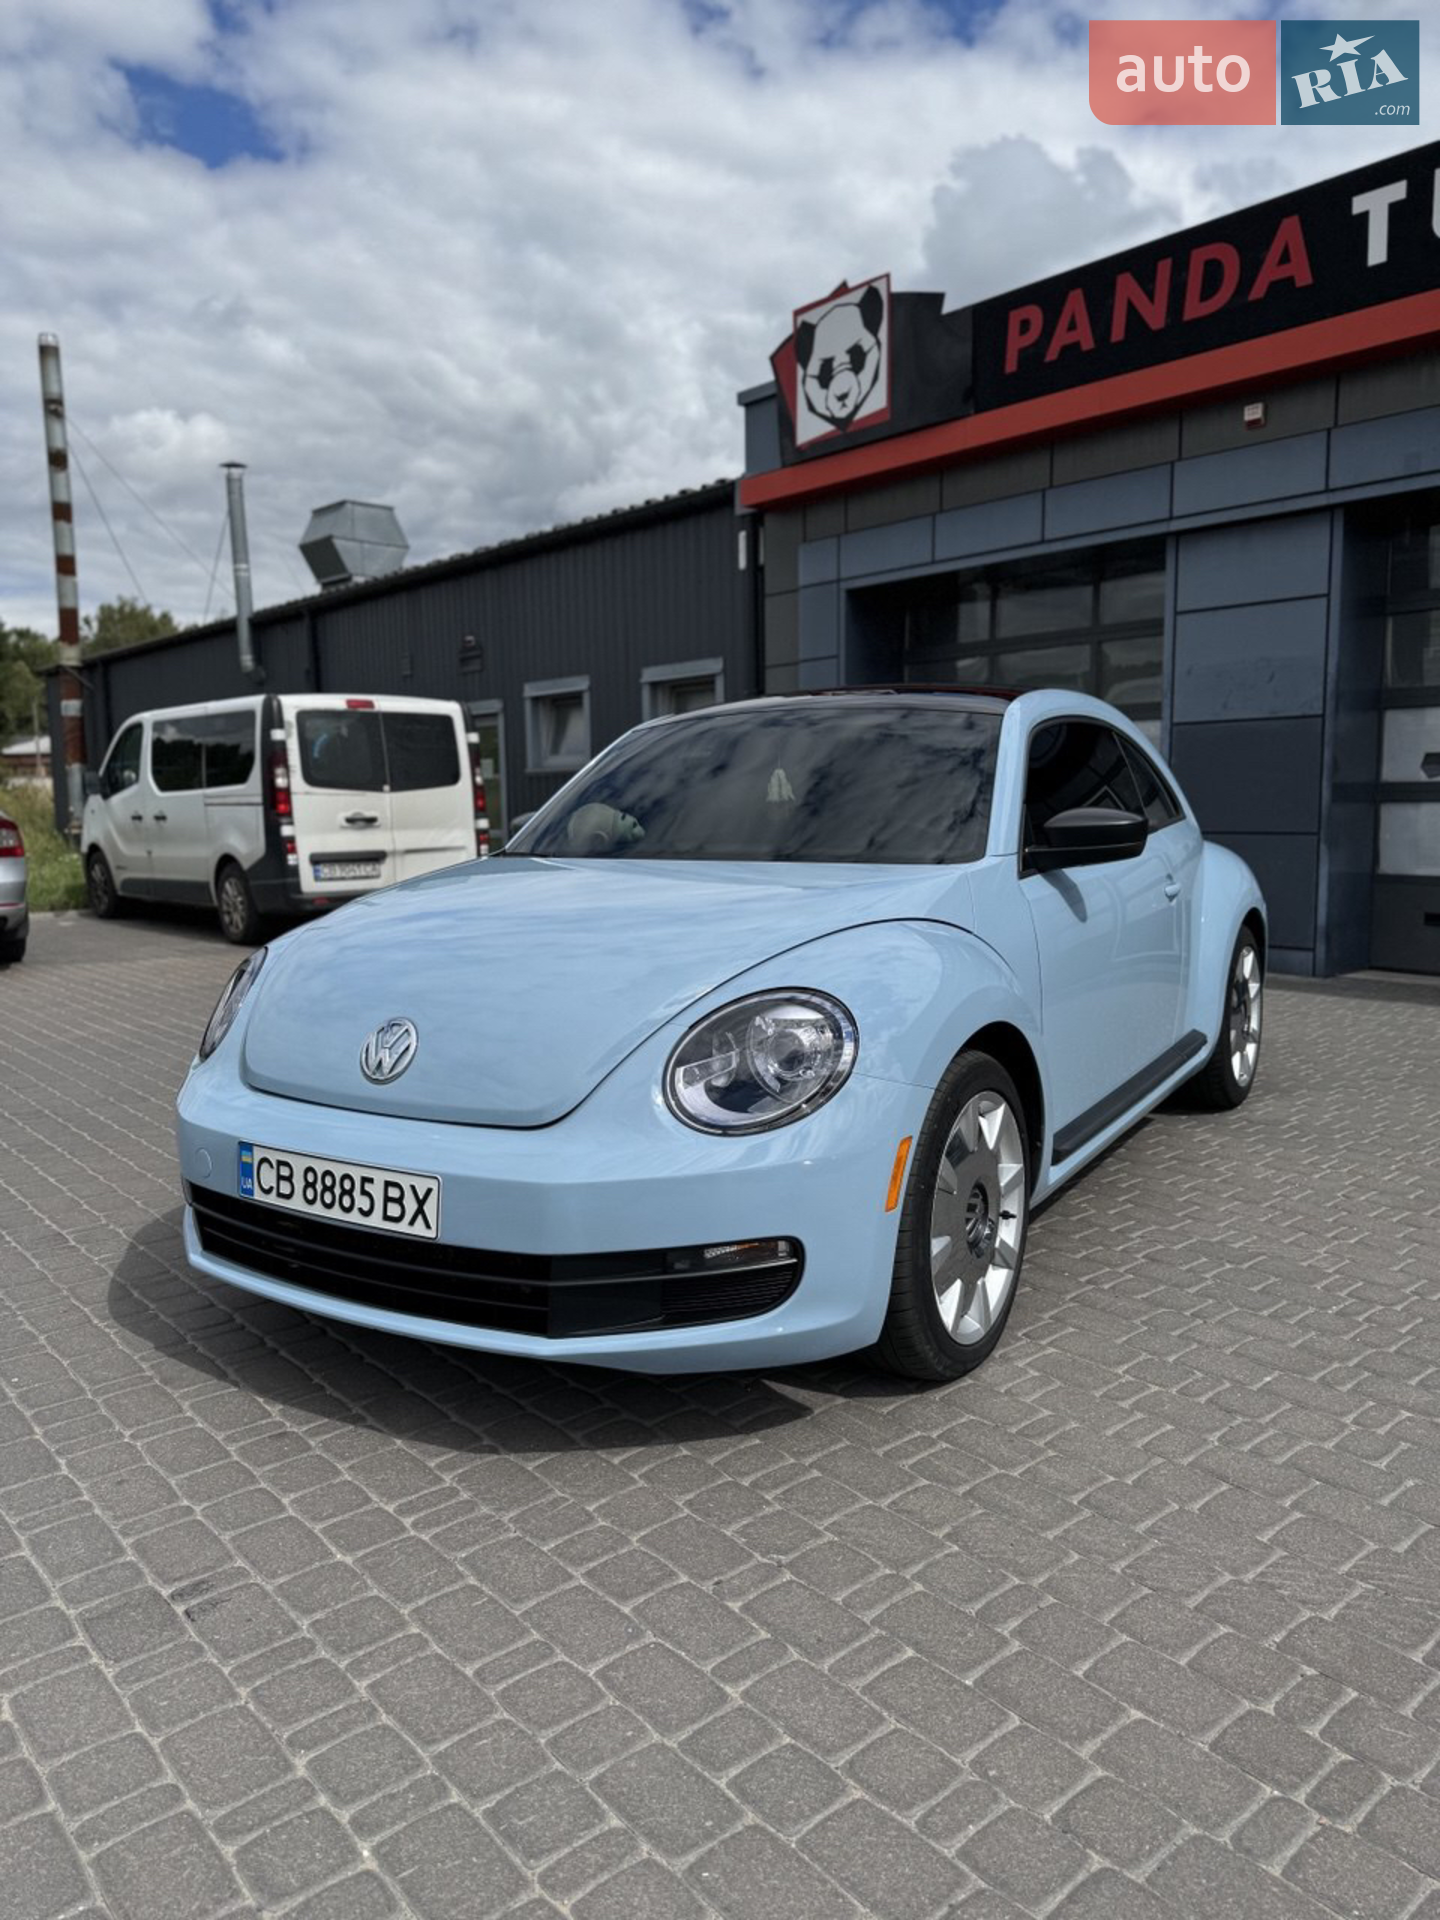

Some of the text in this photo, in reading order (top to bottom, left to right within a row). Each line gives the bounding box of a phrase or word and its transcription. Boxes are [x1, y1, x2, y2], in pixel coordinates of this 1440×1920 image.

[1004, 167, 1440, 376] PANDA T
[256, 1156, 434, 1230] CB 8885 BX
